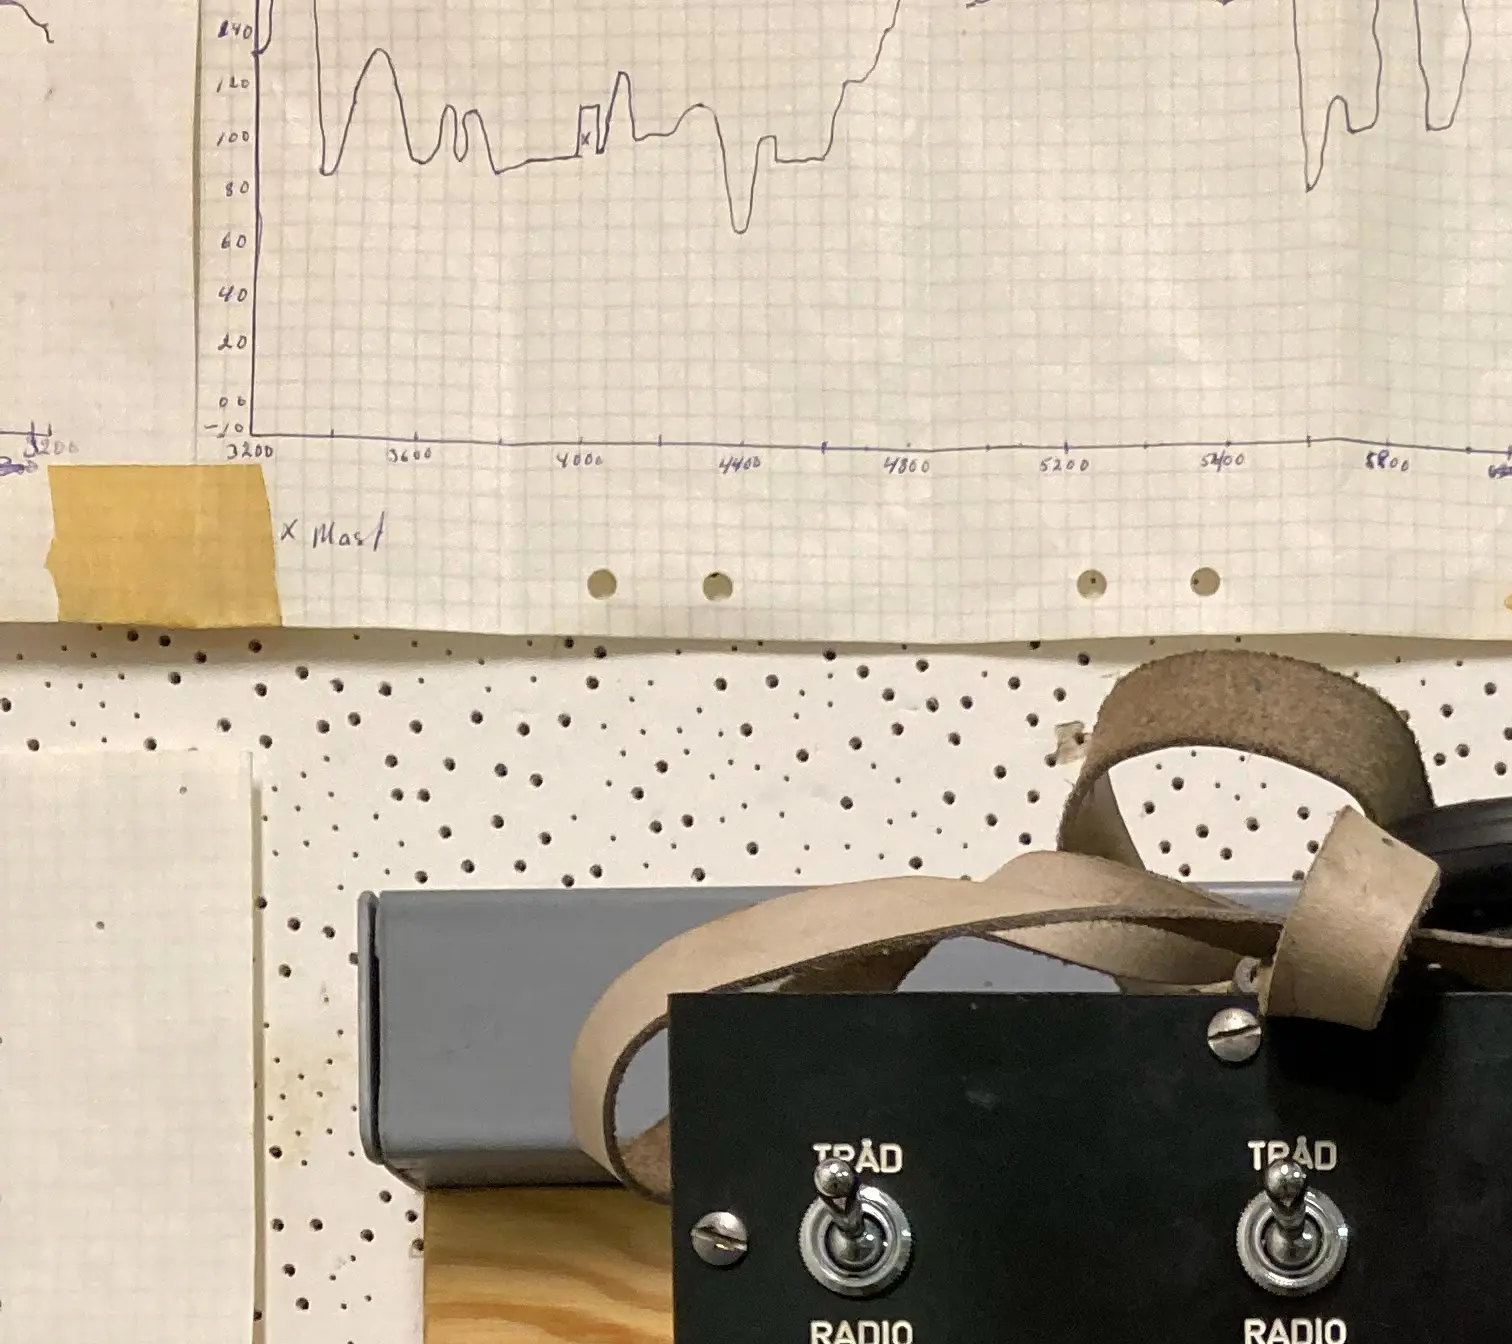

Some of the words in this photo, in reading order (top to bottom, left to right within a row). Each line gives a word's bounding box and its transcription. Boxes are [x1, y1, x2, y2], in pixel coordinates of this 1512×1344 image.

[216, 76, 250, 93] 120
[216, 130, 250, 146] 100
[225, 181, 250, 197] 80
[221, 232, 247, 249] 60
[218, 285, 248, 302] 40
[217, 333, 248, 351] 20
[226, 441, 274, 460] 3200
[387, 447, 432, 463] 3600
[556, 451, 604, 468] 4000
[718, 455, 762, 473] 4400
[883, 456, 931, 474] 4800
[1040, 456, 1090, 473] 5200
